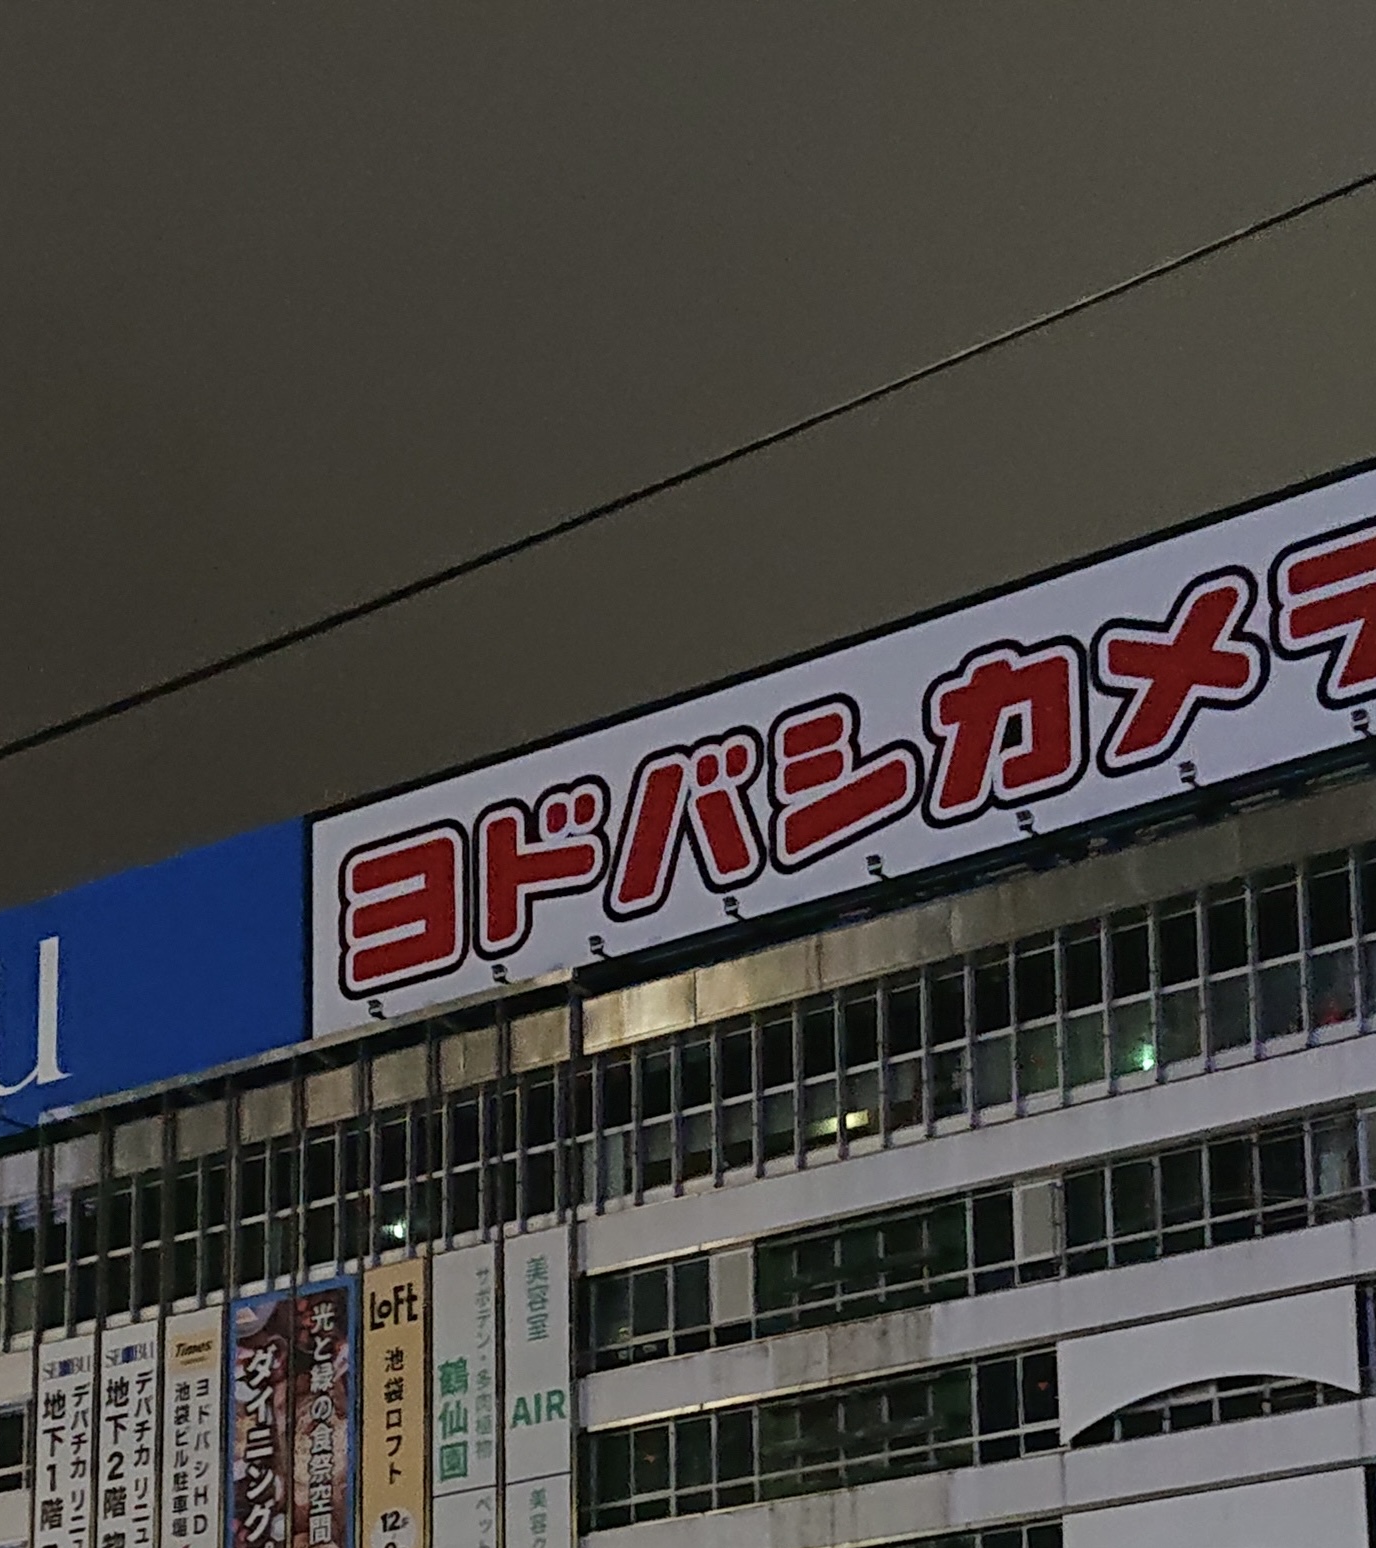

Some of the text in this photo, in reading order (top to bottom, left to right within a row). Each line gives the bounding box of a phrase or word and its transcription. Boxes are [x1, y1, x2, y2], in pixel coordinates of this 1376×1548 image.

[175, 1340, 212, 1358] Times
[526, 1255, 549, 1342] 美容室
[40, 1390, 66, 1531] 地下1階
[102, 1376, 129, 1519] 地下2階
[172, 1383, 191, 1538] 池袋ビル駐車場
[192, 1379, 209, 1535] ヨドバシHD
[384, 1347, 405, 1485] 池袋ロフト
[510, 1389, 566, 1428] AIR
